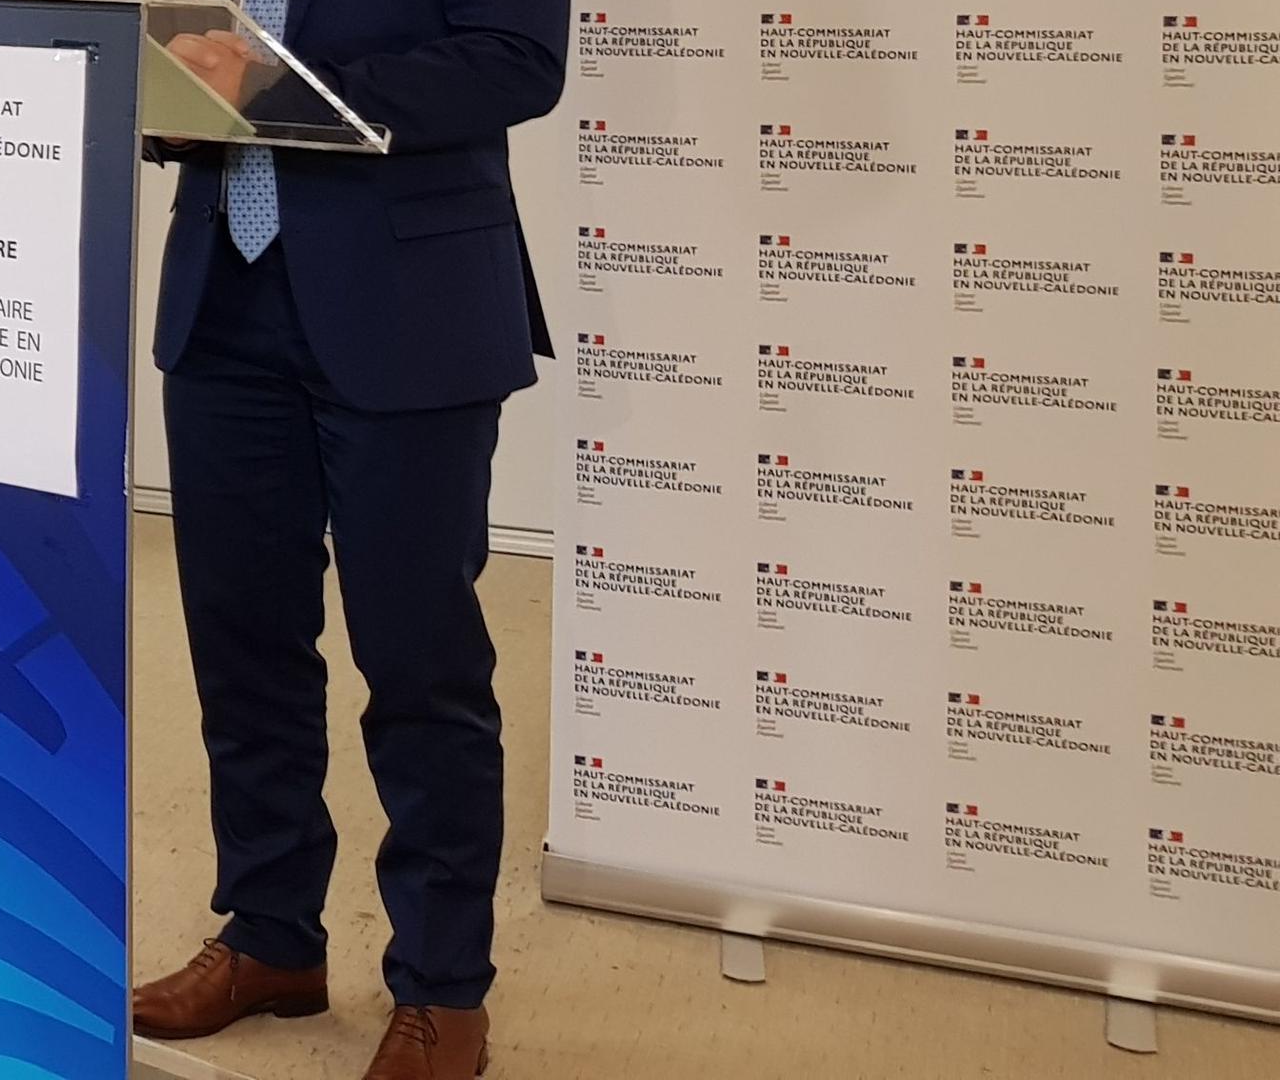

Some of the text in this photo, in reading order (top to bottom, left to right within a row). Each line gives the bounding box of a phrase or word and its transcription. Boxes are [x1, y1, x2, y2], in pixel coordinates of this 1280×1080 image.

[761, 28, 890, 37] HAUT-COMMISSARIAT
[761, 38, 870, 48] DE LA RÉPUBLIQUE
[761, 49, 917, 59] EN NOUVELLE-CALÉDONIE
[576, 134, 698, 145] HAUT-COMMISSARIAT
[576, 144, 679, 155] DE LA RÉPUBLIQUE
[955, 144, 1092, 155] HAUT-COMMISSARIAT
[594, 155, 723, 167] NOUVELLE-CALÉDONIE
[955, 154, 1070, 166] DE LA RÉPUBLIQUE
[954, 165, 1120, 179] EN NOUVELLE-CALÉDONIE
[759, 249, 888, 262] HAUT-COMMISSARIAT
[759, 259, 868, 272] DE LA RÉPUBLIQUE
[759, 270, 914, 285] EN NOUVELLE-CALÉDONIE
[17, 331, 40, 352] EN
[575, 348, 696, 362] HAUT-COMMISSARIAT
[575, 358, 677, 372] DE LA RÉPUBLIQUE
[575, 368, 722, 385] EN NOUVELLE-CALÉDONIE
[952, 370, 1088, 387] HAUT-COMMISSARIAT
[952, 381, 1067, 396] DE LA RÉPUBLIQUE
[952, 392, 1116, 411] EN NOUVELLE-CALÉDONIE
[758, 468, 886, 485] HAUT-COMMISSARIAT
[758, 478, 866, 494] DE LA RÉPUBLIQUE
[758, 489, 912, 509] EN NOUVELLE-CALÉDONIE
[575, 559, 695, 578] HAUT-COMMISSARIAT
[575, 569, 676, 586] DE LA RÉPUBLIQUE
[575, 579, 588, 588] EN
[593, 581, 720, 601] NOUVELLE-CALÉDONIE
[949, 594, 1084, 615] HAUT-COMMISSARIAT
[949, 605, 1063, 624] DE LA RÉPUBLIQUE
[949, 616, 964, 625] EN
[969, 618, 1112, 640] NOUVELLE-CALÉDONIE
[756, 684, 883, 706] HAUT-COMMISSARIAT
[756, 695, 863, 714] DE LA RÉPUBLIQUE
[756, 705, 770, 714] EN
[775, 707, 910, 731] NOUVELLE-CALÉDONIE
[1150, 740, 1166, 750] DE
[1171, 742, 1187, 752] LA
[1150, 751, 1167, 761] EN
[945, 816, 1080, 841] HAUT-COMMISSARIAT
[945, 826, 1059, 849] DE LA RÉPUBLIQUE
[945, 837, 960, 847] EN
[965, 840, 1108, 867] NOUVELLE-CALÉDONIE
